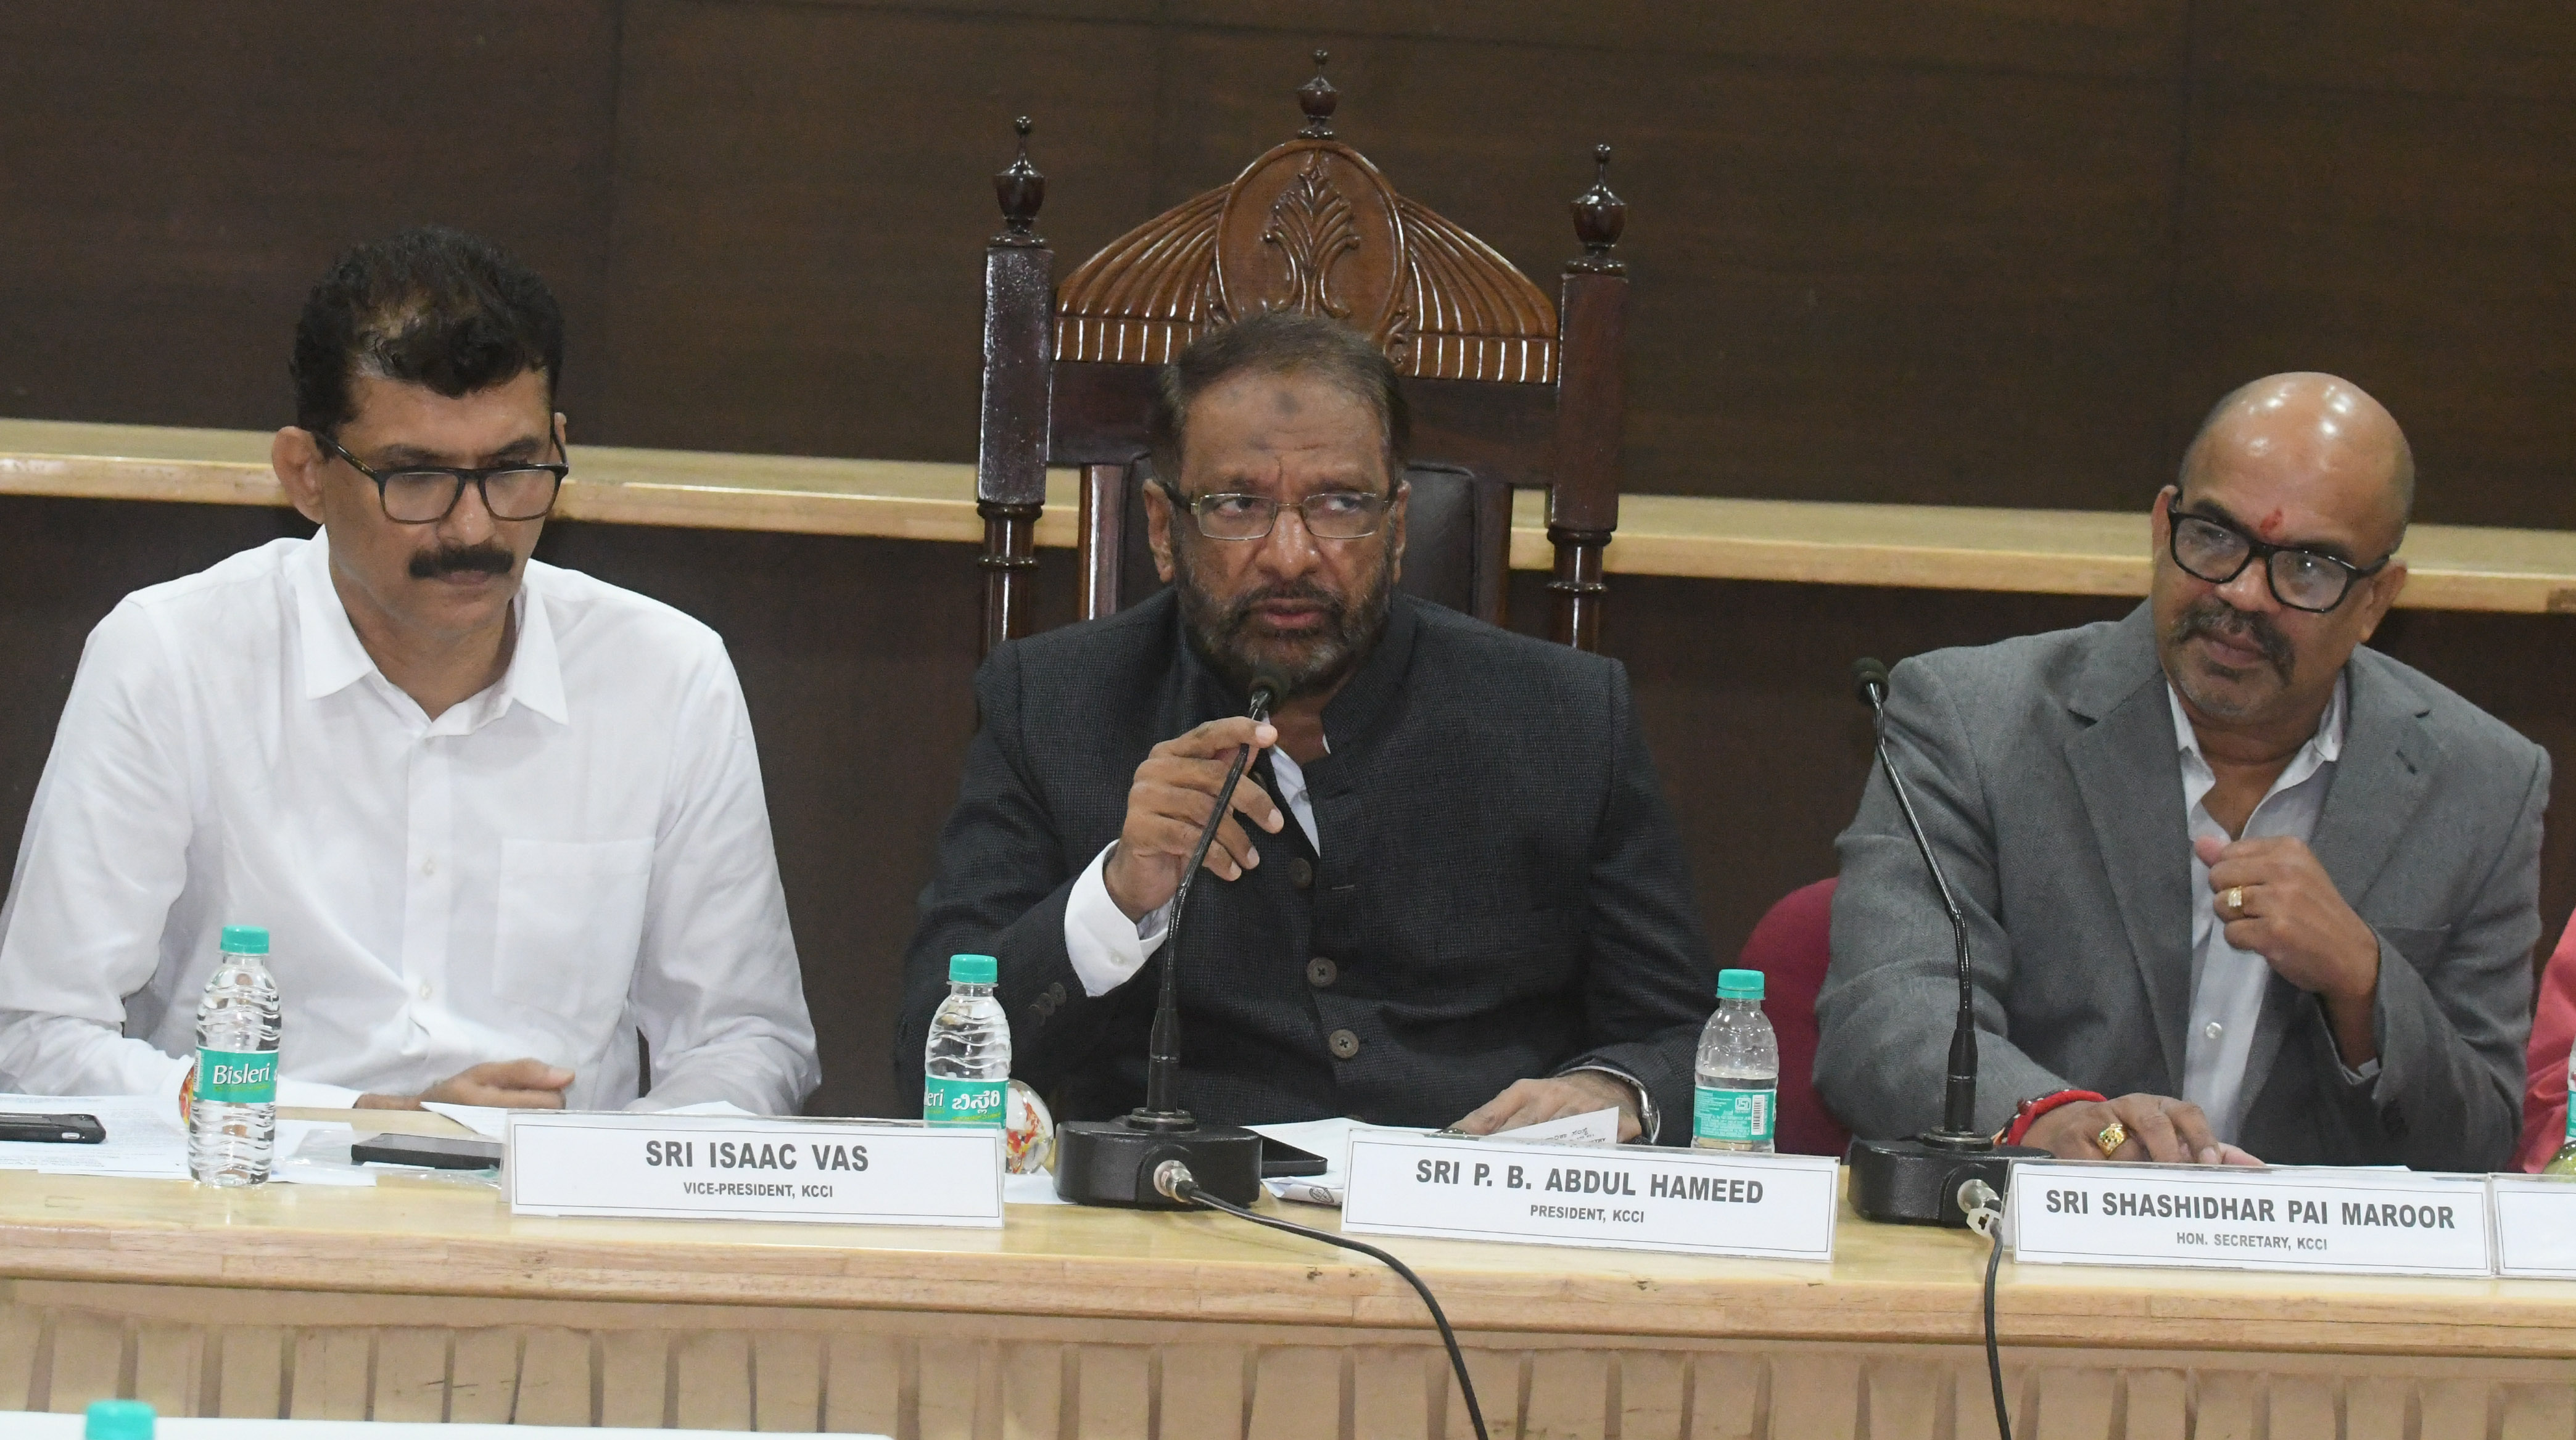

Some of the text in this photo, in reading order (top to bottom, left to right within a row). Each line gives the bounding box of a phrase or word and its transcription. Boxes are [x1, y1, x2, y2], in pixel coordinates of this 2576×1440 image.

[213, 1063, 270, 1084] Bisleri
[924, 1086, 944, 1106] leri
[646, 1140, 869, 1171] SRI ISAAC VAS
[683, 1182, 833, 1199] VICE-PRESIDENT, KCCI
[1416, 1159, 1763, 1204] SRI P. B. ABDUL HAMEED
[1530, 1204, 1644, 1224] PRESIDENT, KCCI
[2046, 1190, 2455, 1229] SRI SHASHIDHAR PAI MAROOR
[2177, 1232, 2327, 1251] HON. SECRETARY, KCCI
